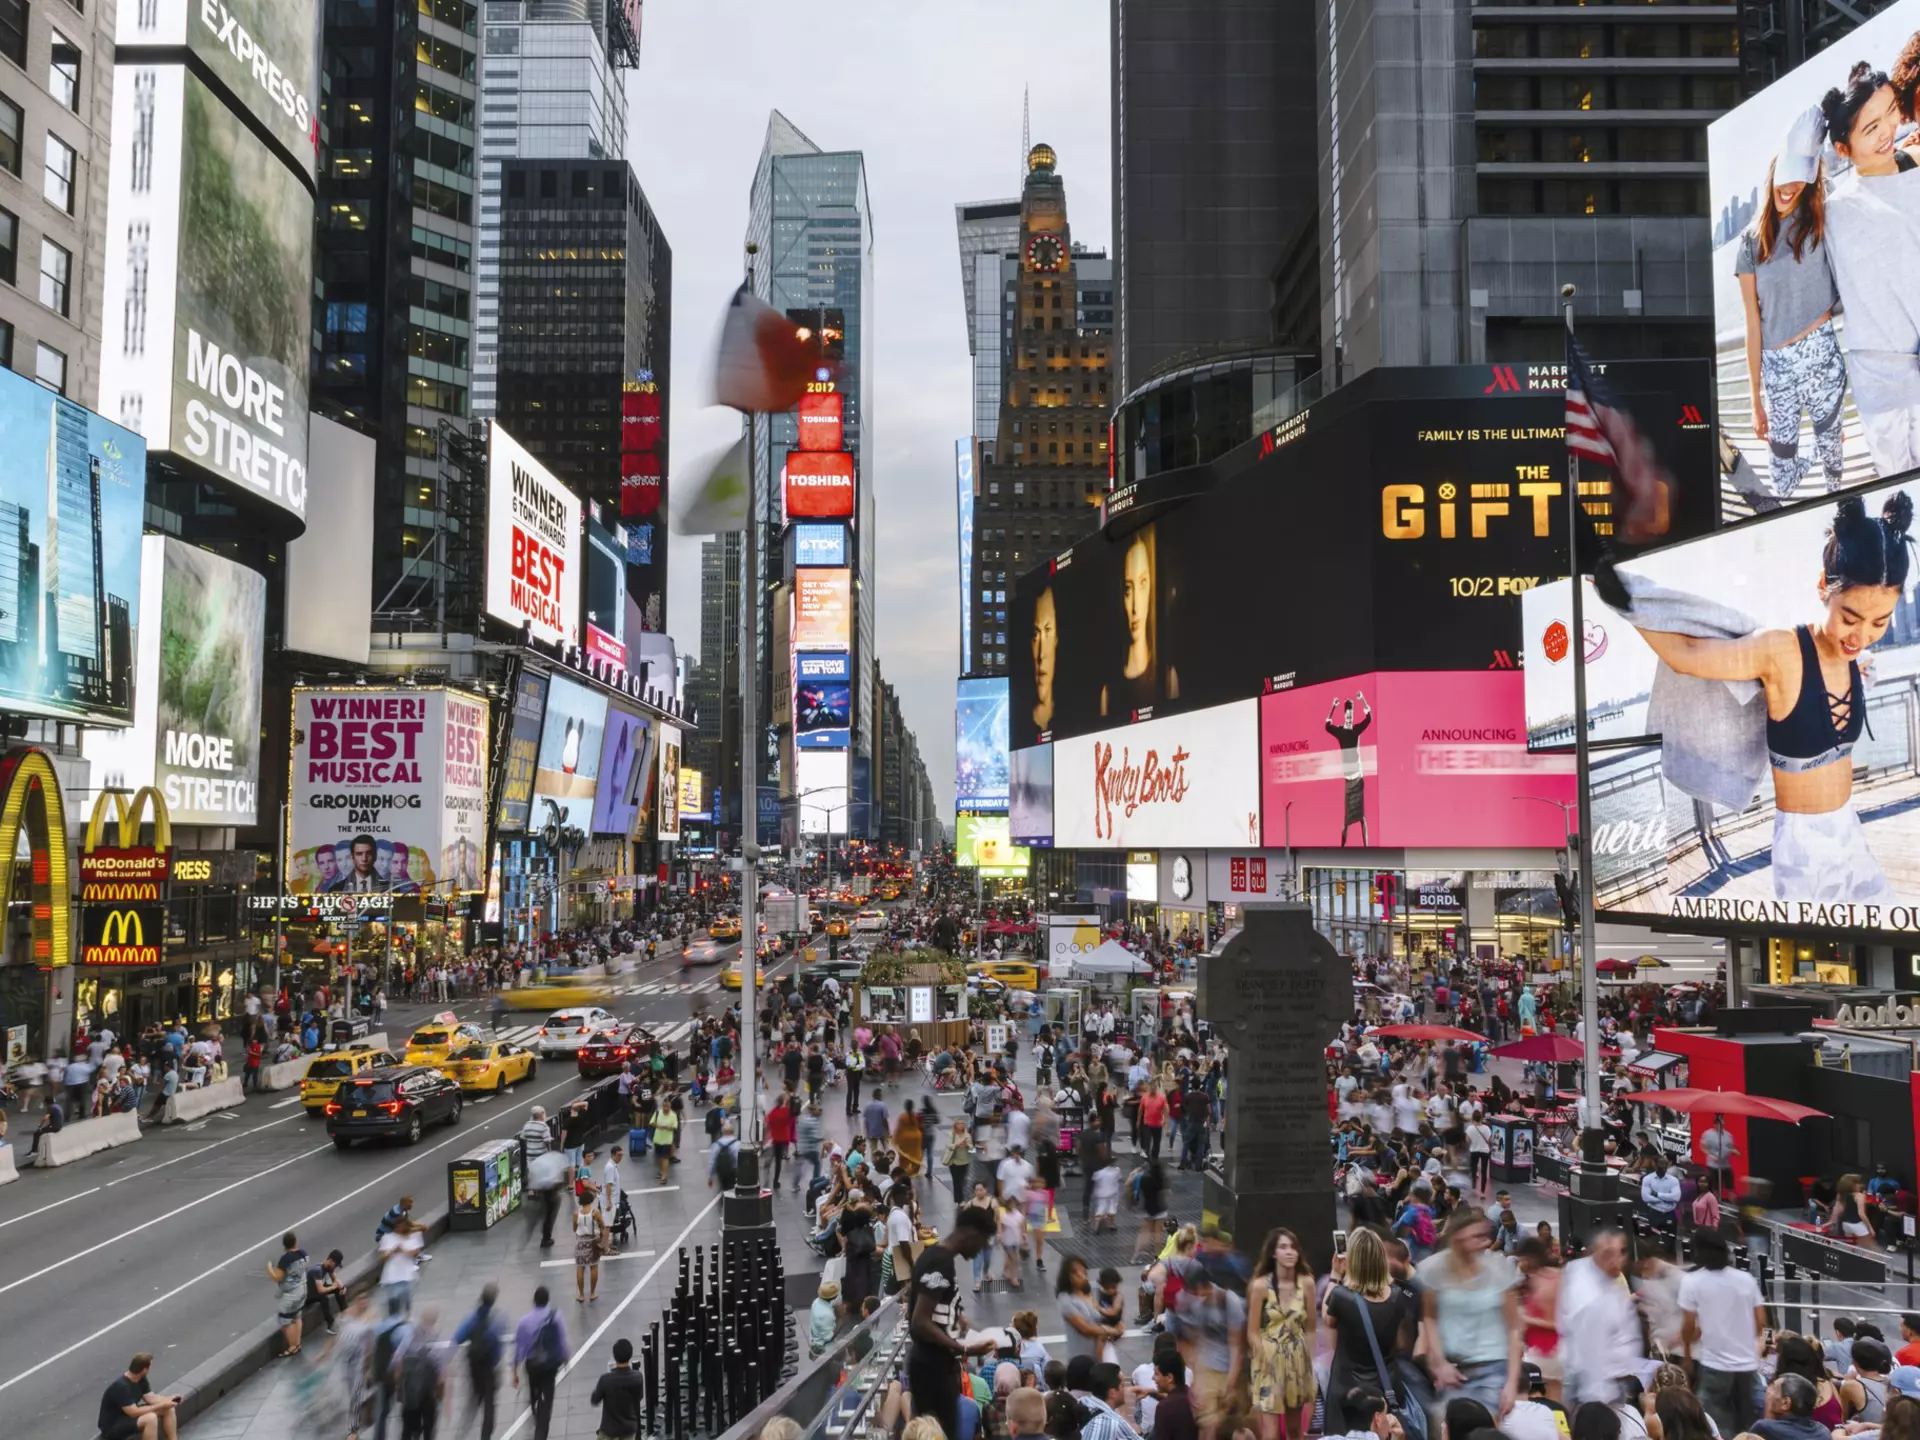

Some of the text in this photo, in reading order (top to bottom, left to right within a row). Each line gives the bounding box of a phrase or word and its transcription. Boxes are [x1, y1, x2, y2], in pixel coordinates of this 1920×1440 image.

[201, 0, 309, 132] EXPRESS
[1528, 365, 1607, 376] MARRTT
[187, 328, 284, 437] MORE
[807, 382, 835, 393] 2017
[802, 415, 839, 423] TOSHIBA
[1275, 409, 1310, 436] MARRIOTT
[1275, 423, 1306, 448] MARQUIS
[1418, 428, 1567, 441] FAMILY IS THE ULTIMAT
[1516, 465, 1550, 479] THE
[789, 474, 851, 486] TOSHIBA
[511, 460, 567, 532] WINNER!
[512, 499, 566, 549] 6 TONY AWARDS
[811, 539, 840, 549] TDK
[511, 523, 565, 604] BEST
[1449, 576, 1540, 596] 10/2 FOX
[510, 578, 564, 633] MUSICAL
[1273, 672, 1296, 682] MARRIOTT
[1273, 681, 1294, 690] MARQUIS
[310, 698, 426, 720] WINNER!
[446, 699, 485, 730] WINNER!
[308, 722, 424, 760] BEST
[1421, 729, 1517, 741] ANNOUNCING
[165, 730, 234, 772] MORE
[445, 722, 484, 766] BEST
[1269, 740, 1309, 755] ANNOUNCING
[308, 762, 422, 783] MUSICAL
[444, 763, 483, 788] MUSICAL
[165, 774, 257, 814] STRETCH
[1094, 740, 1191, 840] Kinky Boots
[309, 794, 421, 810] GROUNDHOG
[960, 798, 975, 807] LIVE
[975, 798, 1002, 807] SUNDAY
[348, 809, 380, 824] DAY
[337, 825, 391, 833] THE MUSICAL
[82, 857, 166, 870] McDonald's
[1251, 861, 1265, 874] UNI
[95, 870, 151, 878] Restaurant
[1251, 877, 1265, 889] QLO
[247, 896, 393, 909] GIFTS LUGAGE
[1669, 897, 1789, 923] AMERICAN
[1798, 901, 1882, 929] EAGLE
[142, 976, 168, 988] EXPRESS
